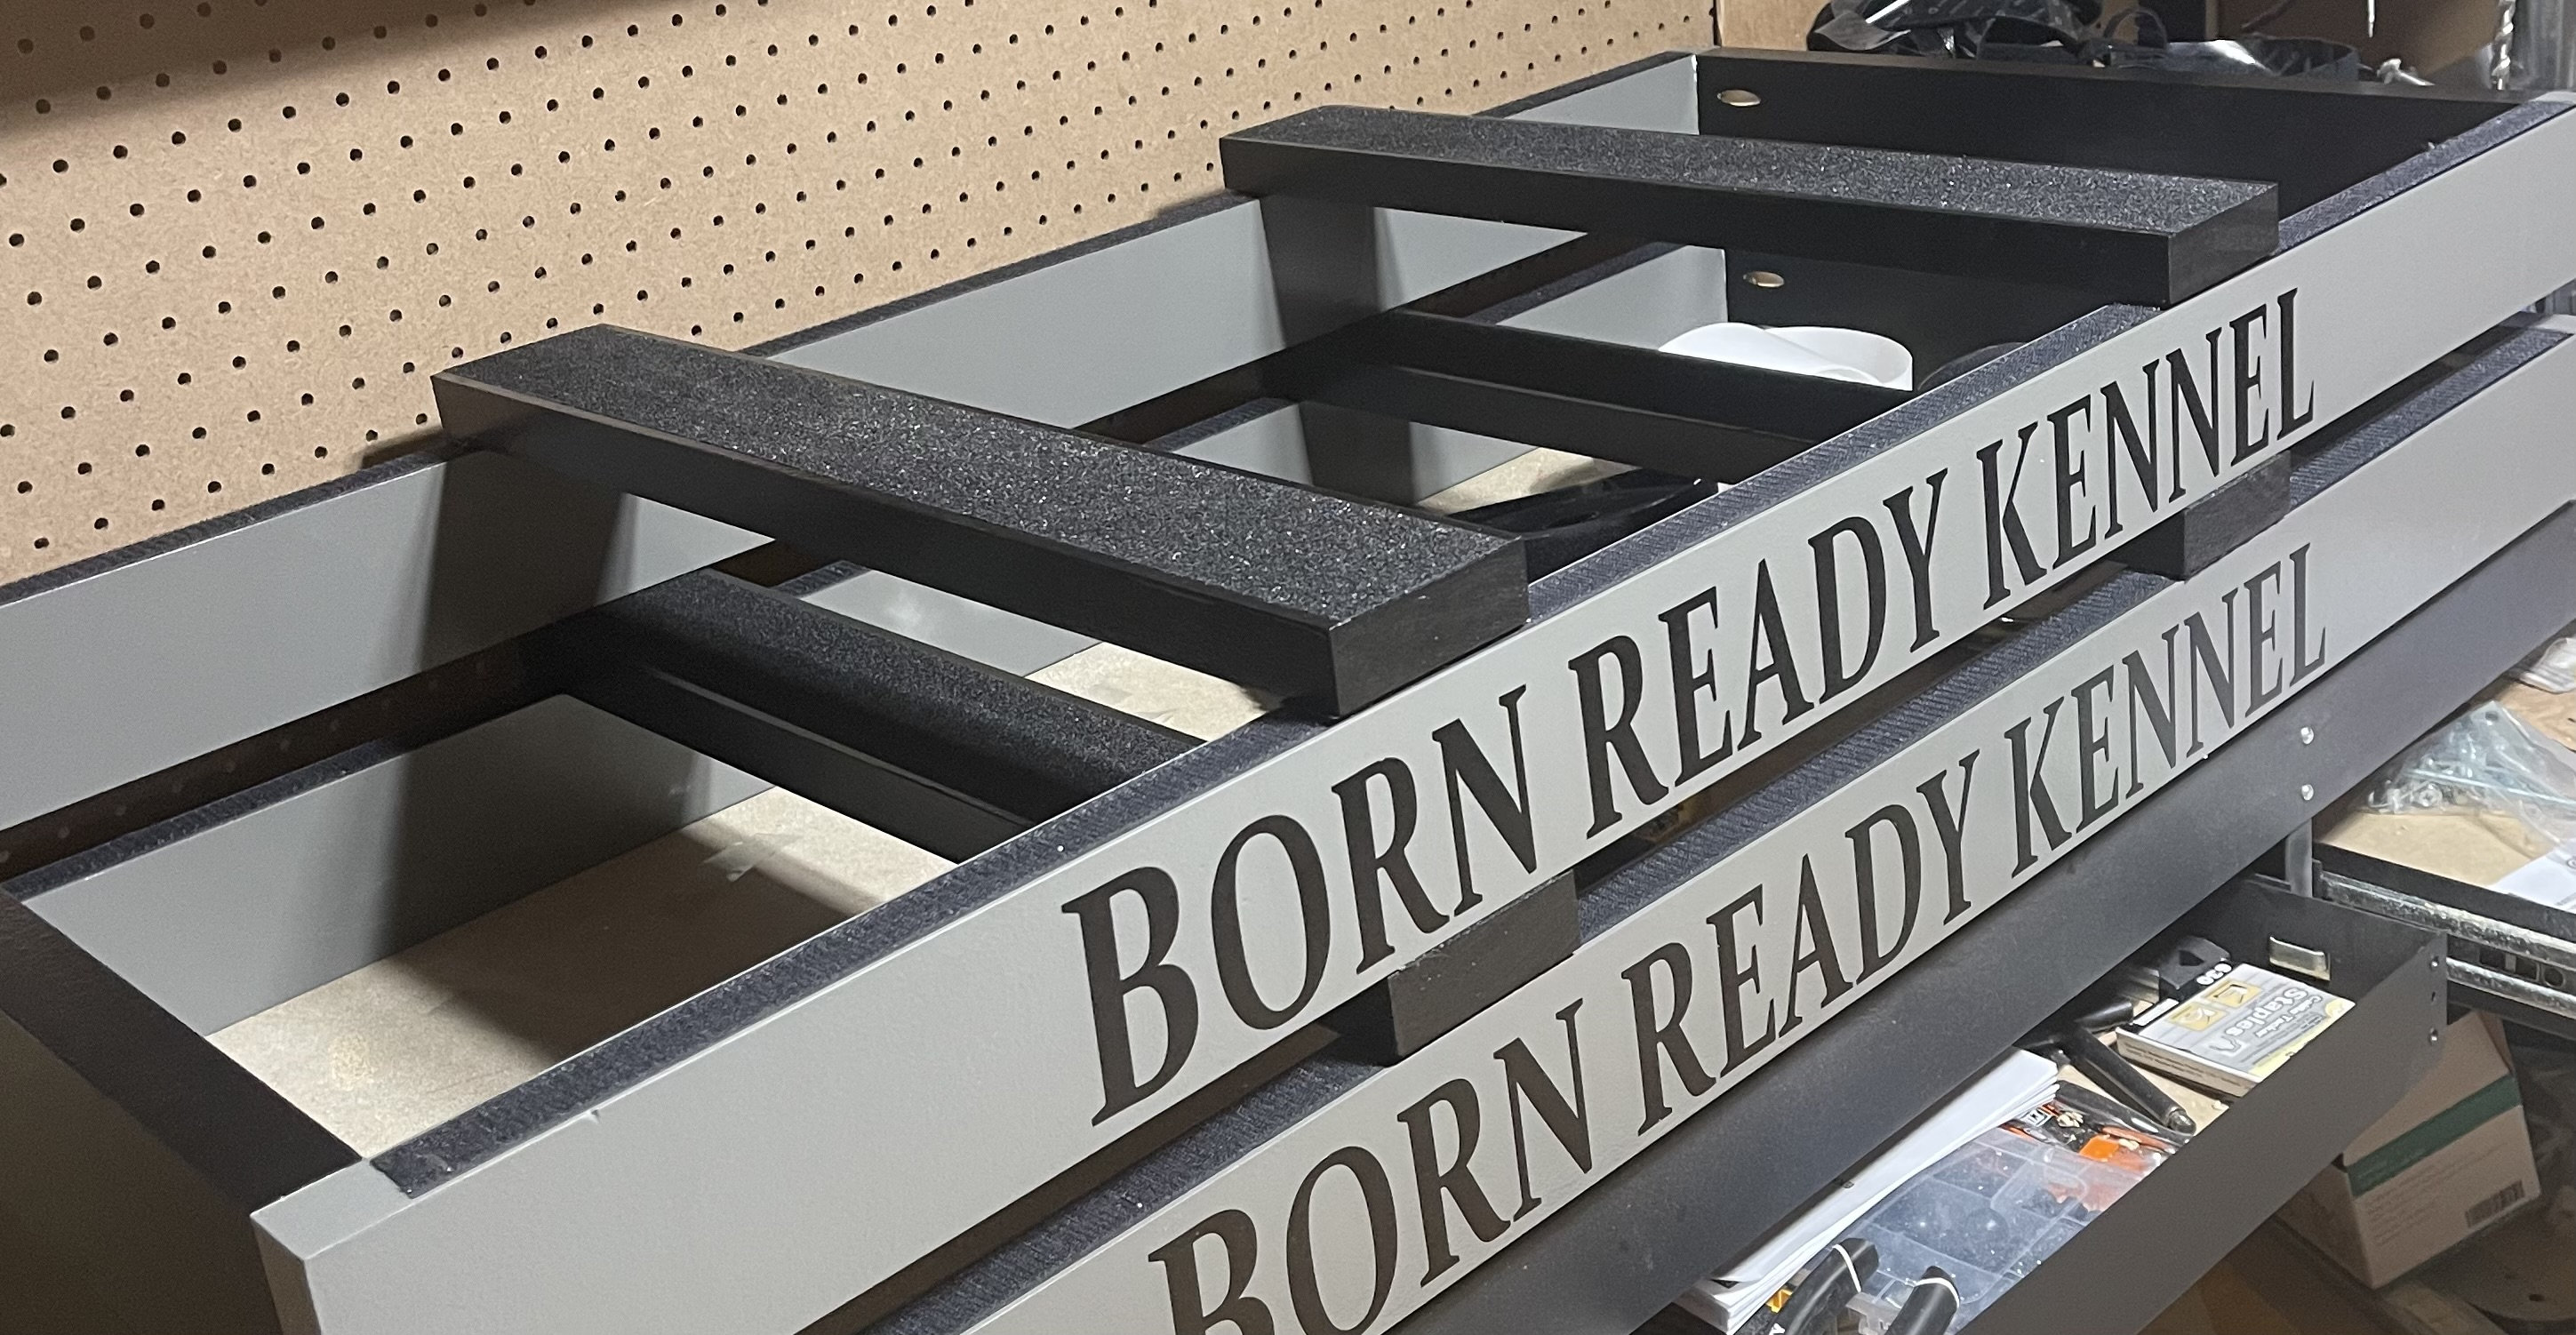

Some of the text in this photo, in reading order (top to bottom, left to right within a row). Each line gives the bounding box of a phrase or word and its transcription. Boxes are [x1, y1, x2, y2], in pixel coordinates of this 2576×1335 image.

[1060, 287, 2315, 1127] BORN READY KENNEL
[1148, 542, 2327, 1335] BORN READY KENNEL
[2225, 987, 2308, 1037] Staples
